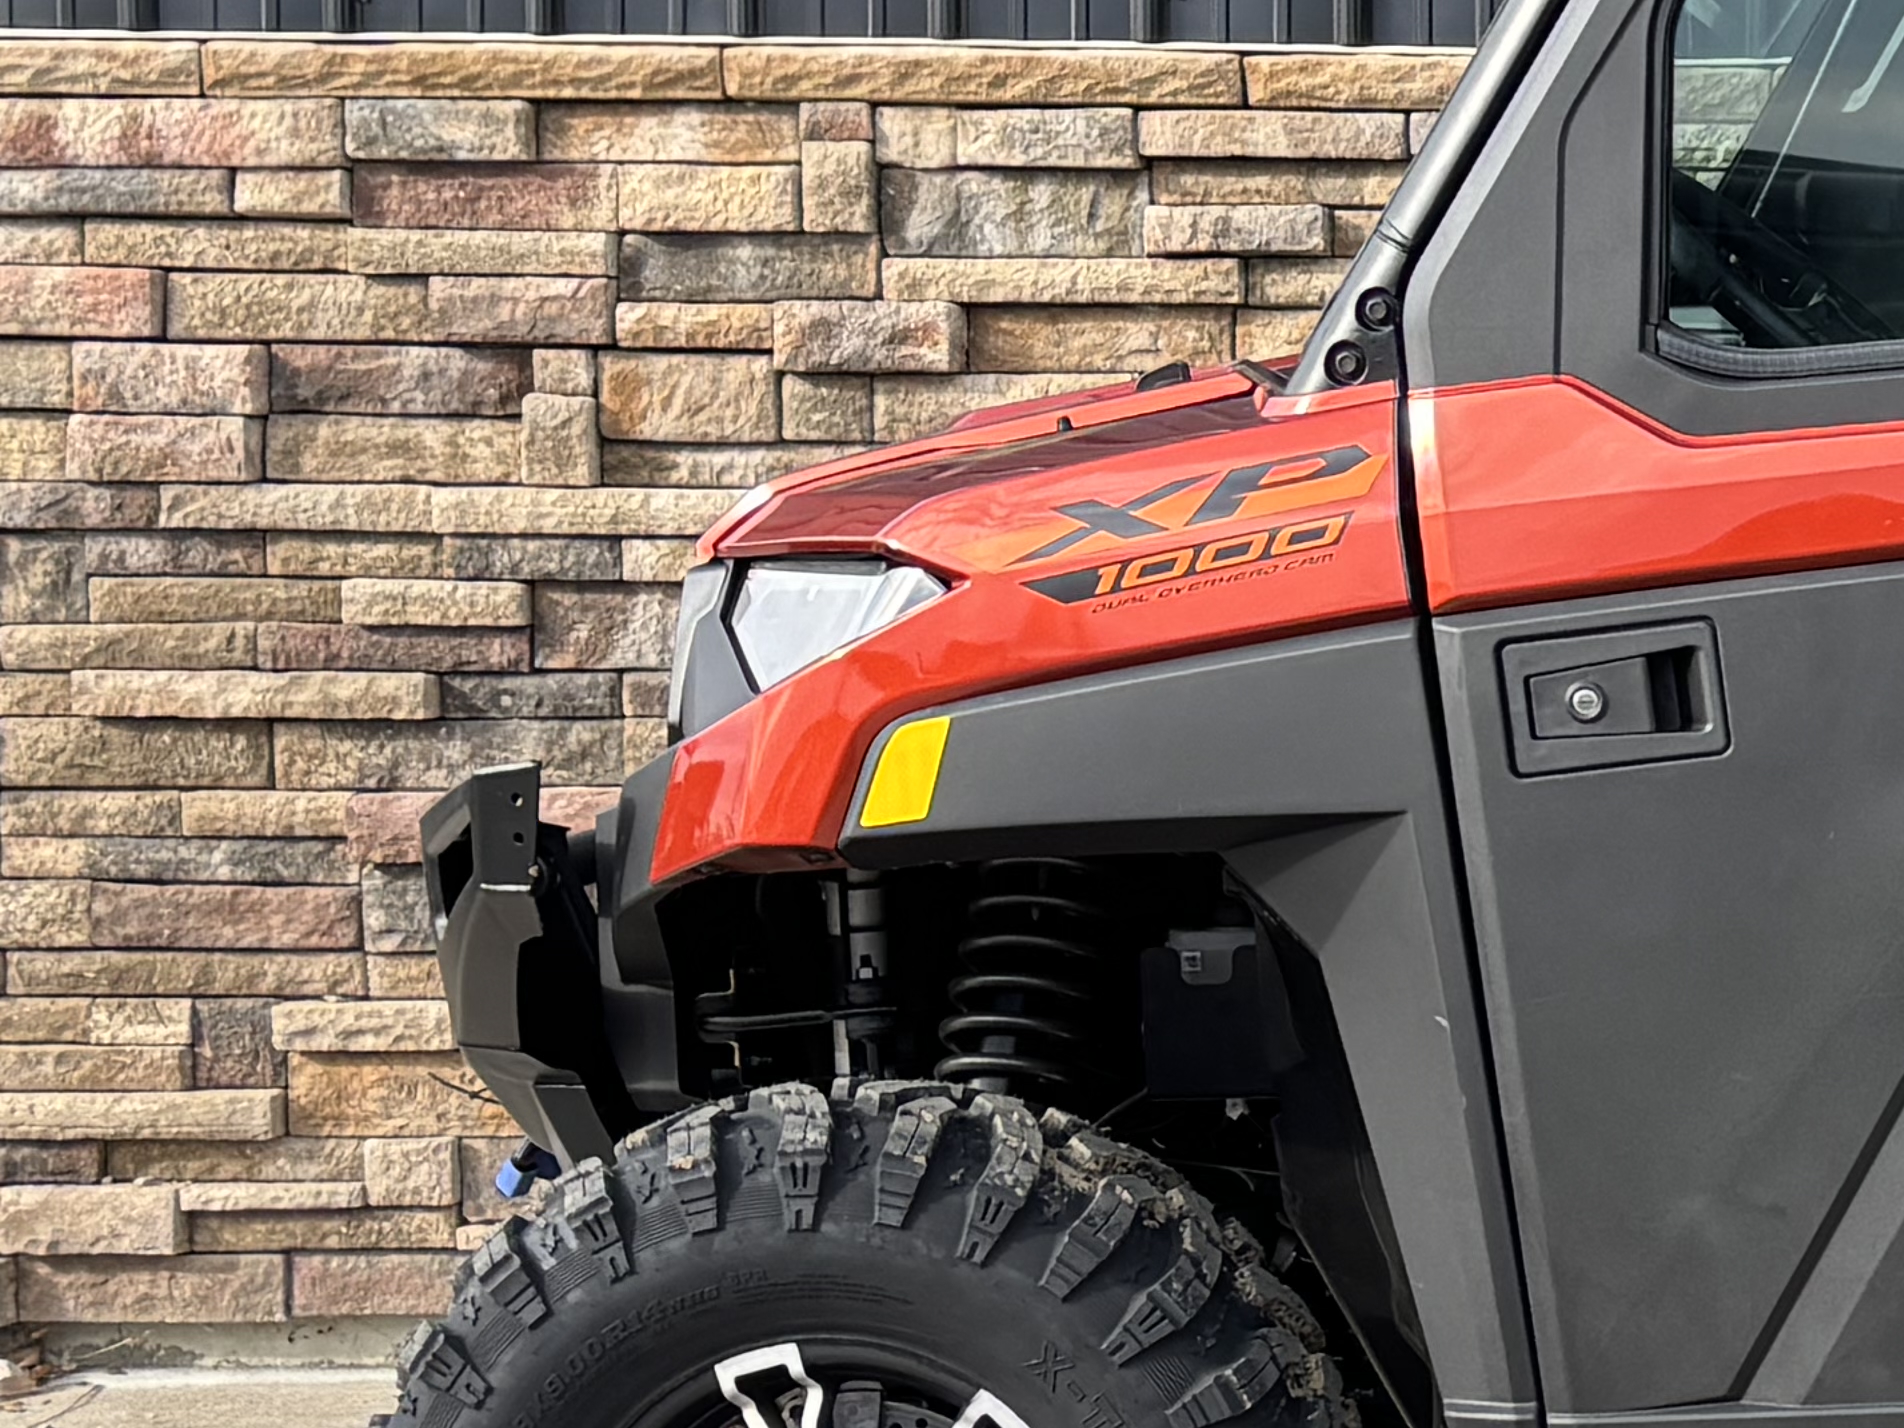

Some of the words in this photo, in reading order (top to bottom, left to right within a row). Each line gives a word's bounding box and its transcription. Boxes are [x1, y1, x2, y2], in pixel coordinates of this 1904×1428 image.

[1004, 444, 1373, 566] XP
[1092, 594, 1150, 614] DUAL
[1158, 565, 1278, 598] OVERHEAD
[1283, 552, 1334, 571] CAM
[1094, 513, 1346, 595] 1000
